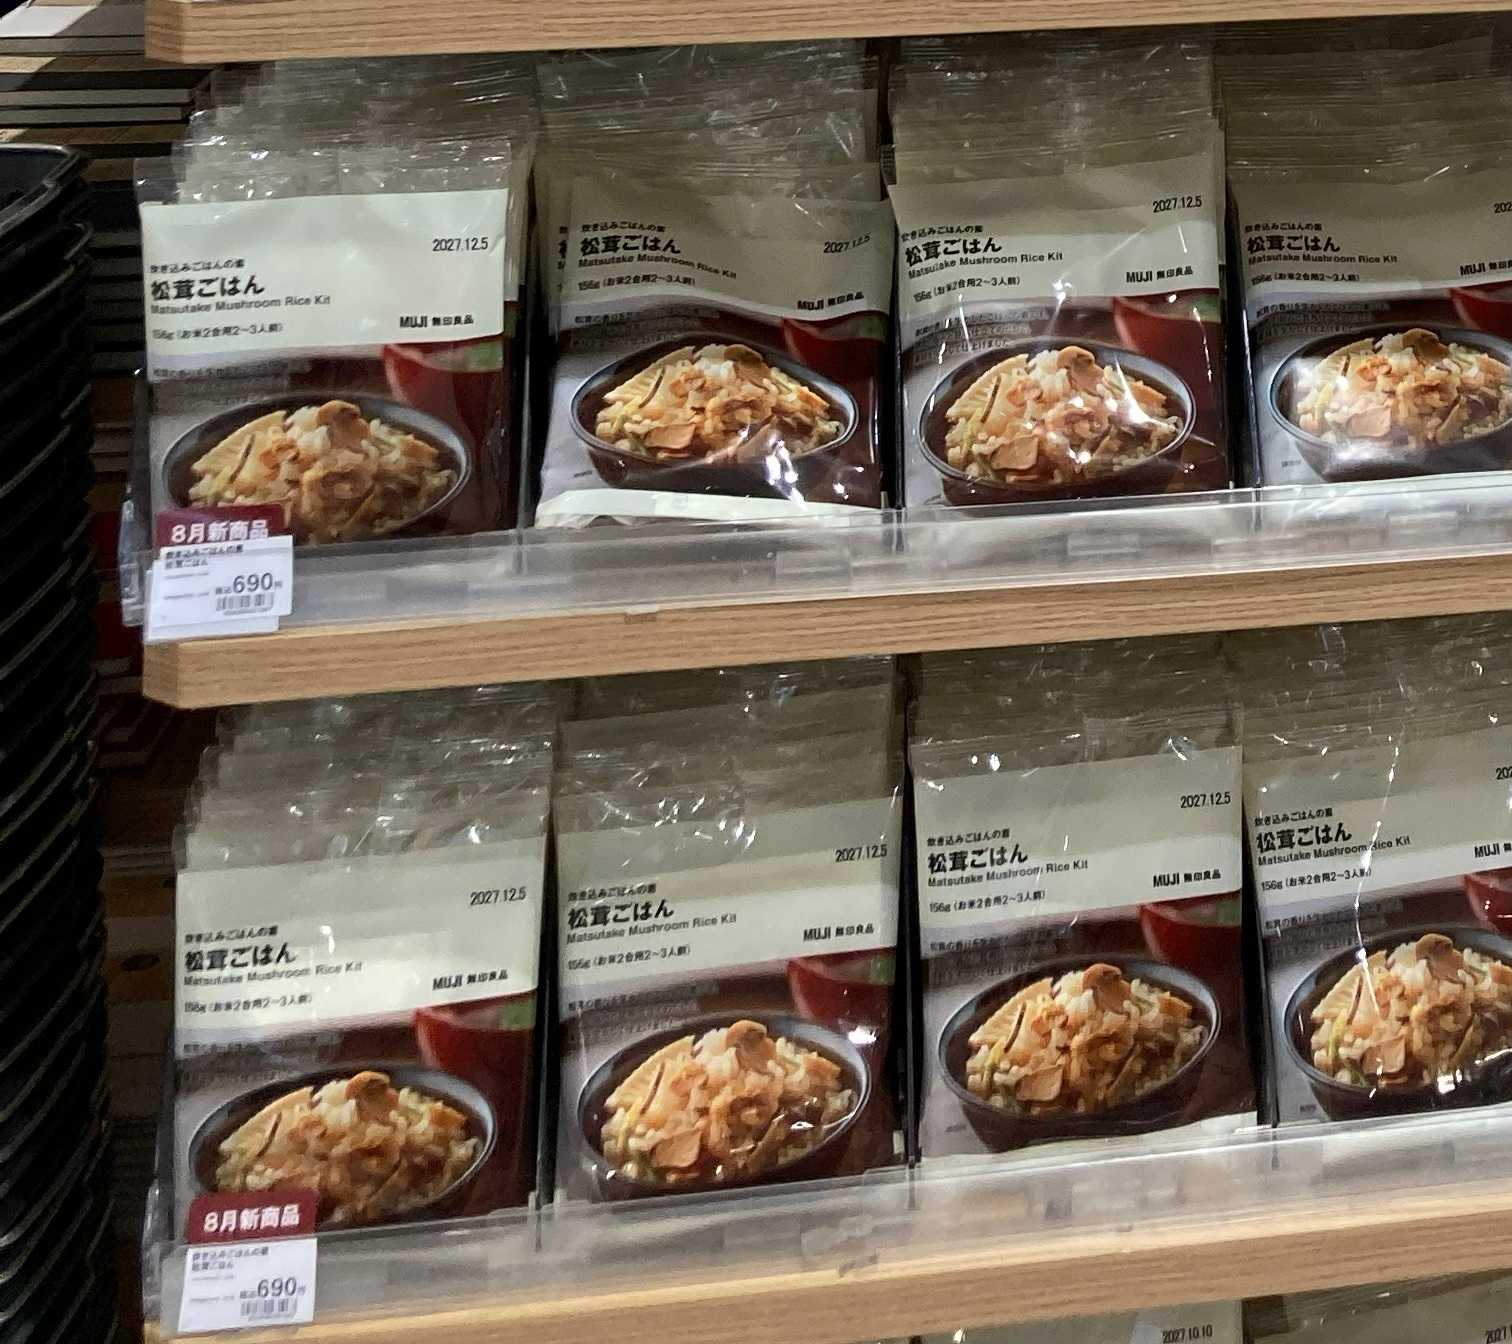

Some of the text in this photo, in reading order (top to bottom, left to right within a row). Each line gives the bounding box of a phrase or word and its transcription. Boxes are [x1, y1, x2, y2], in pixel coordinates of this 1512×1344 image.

[432, 237, 489, 252] 2027.12.5
[580, 234, 681, 256] 松茸ごはん
[905, 237, 1002, 267] 松茸ごはん
[1247, 235, 1341, 253] 松茸ごはん
[959, 254, 1018, 266] Mushroom
[1020, 253, 1045, 262] Rice
[1047, 251, 1063, 262] Kit
[1126, 270, 1153, 283] MUJI
[1459, 264, 1486, 276] MUJI
[151, 275, 265, 302] 松茸ごはん
[796, 300, 824, 310] MUJI
[400, 316, 428, 328] MUJI
[171, 520, 269, 543] 8月新商品
[1180, 792, 1231, 809] 2027.12.5
[1256, 822, 1352, 852] 松茸ごはん
[1474, 843, 1500, 857] MUJI
[928, 844, 1028, 874] 松茸ごはん
[986, 867, 1043, 881] Mushroom
[1046, 862, 1070, 873] Rice
[1073, 860, 1088, 870] Kit
[1153, 873, 1180, 887] MUJI
[567, 899, 674, 929] 松茸ごはん
[803, 927, 831, 941] MUJI
[184, 943, 297, 973] 松茸ごはん
[432, 976, 463, 990] MUJI
[204, 1204, 300, 1232] 8月新商品
